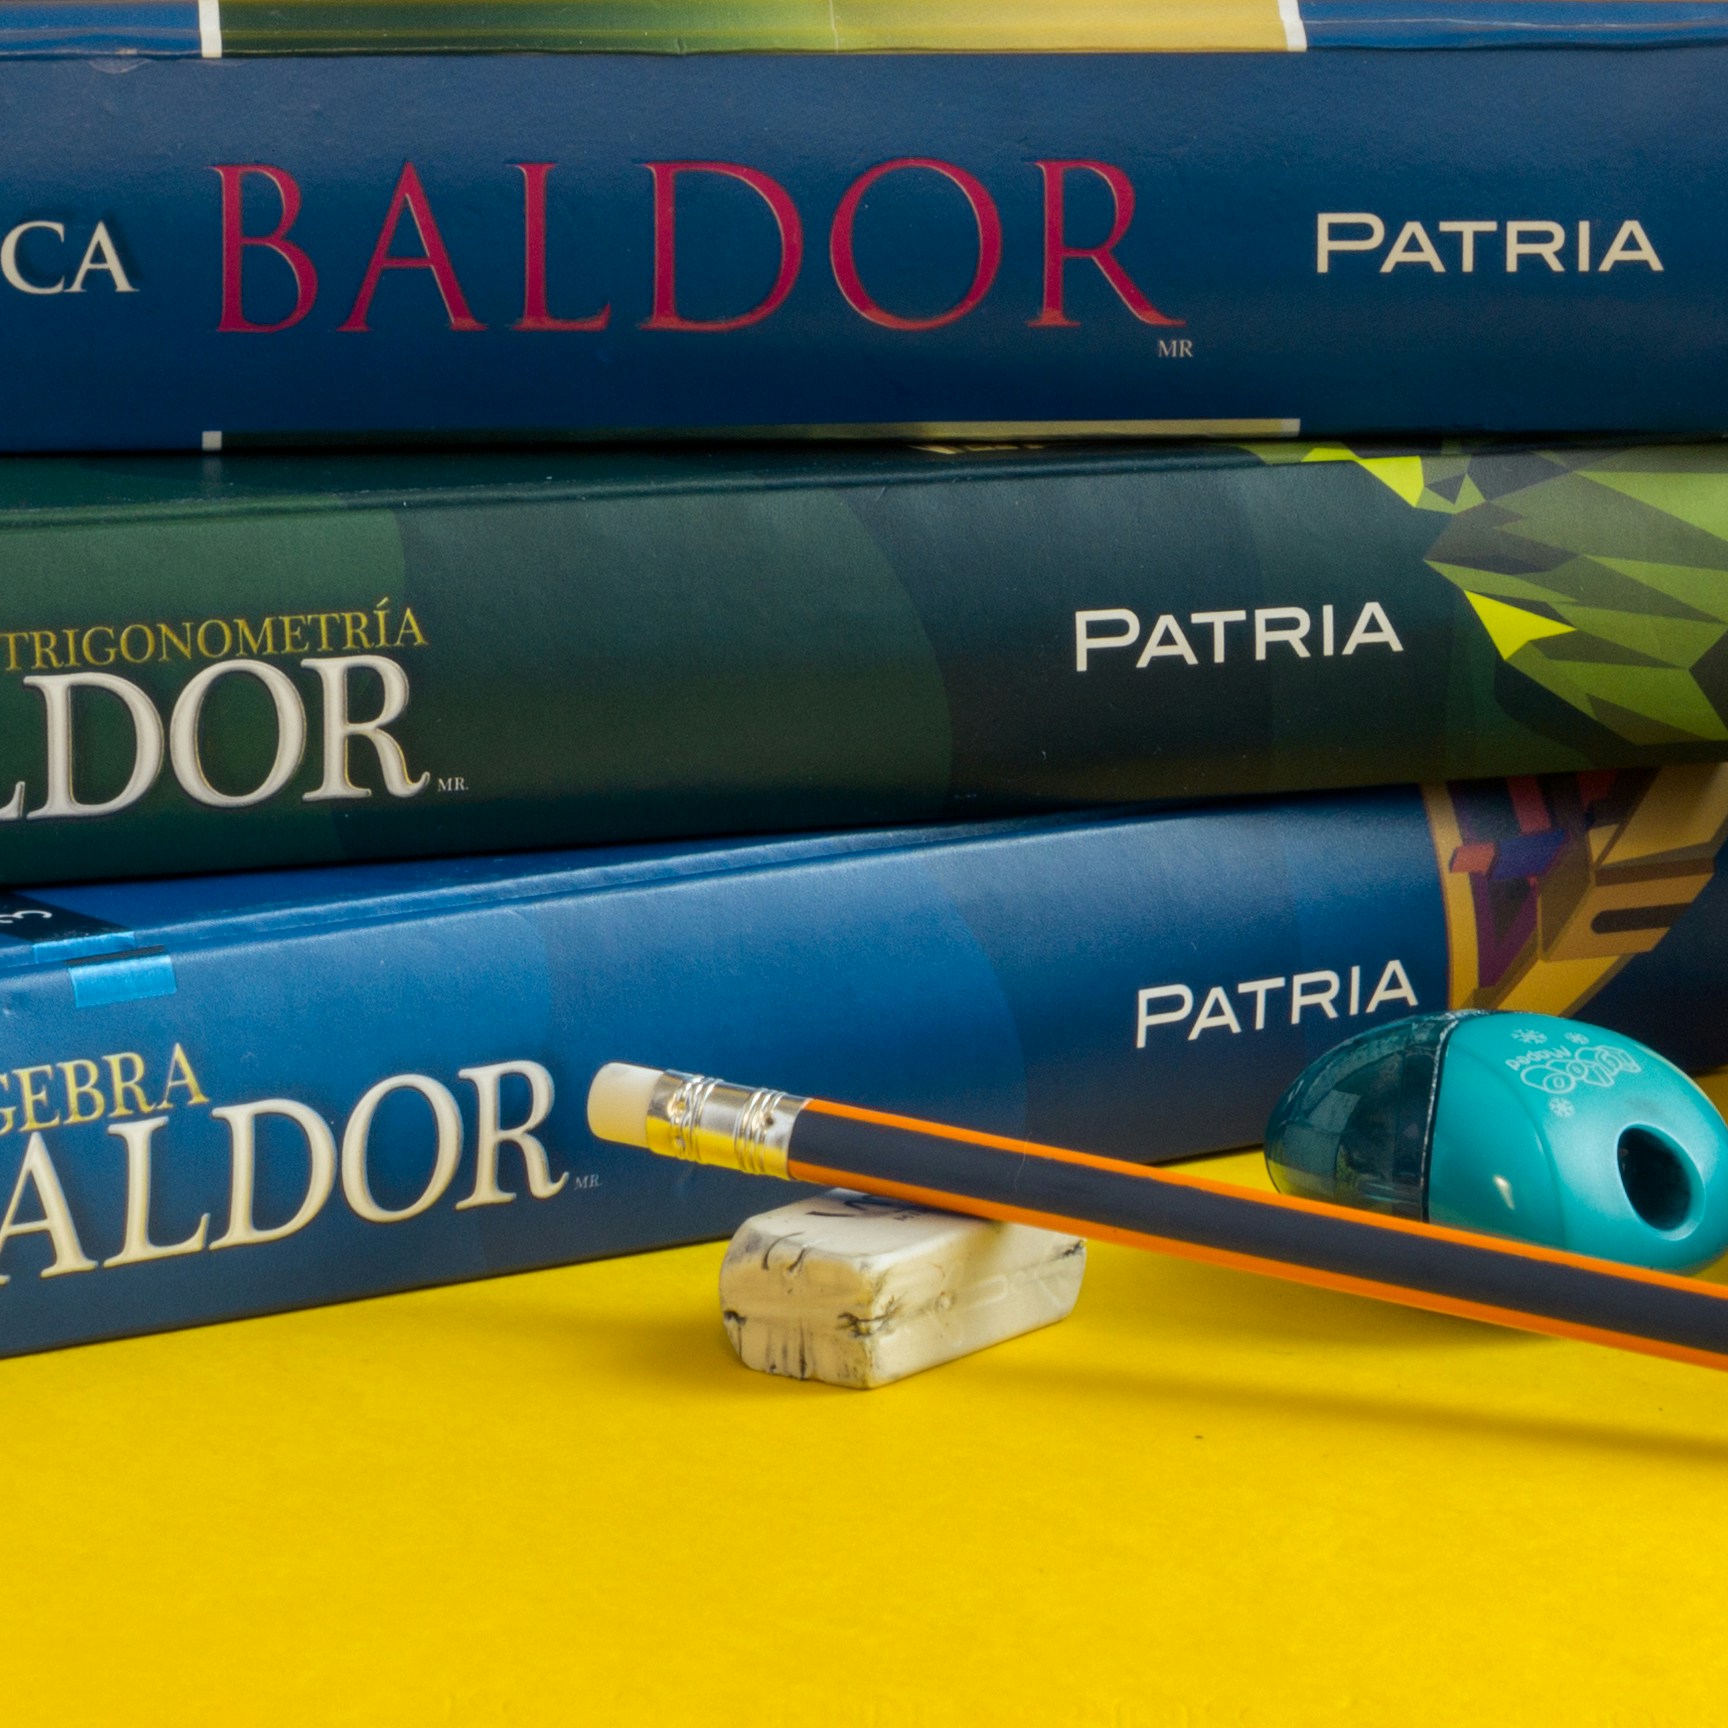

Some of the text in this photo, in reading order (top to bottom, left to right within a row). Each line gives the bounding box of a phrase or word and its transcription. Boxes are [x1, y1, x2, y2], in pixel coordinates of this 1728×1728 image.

[205, 156, 1186, 333] BALDOR
[1315, 212, 1665, 273] PATRIA
[1157, 339, 1194, 358] MR
[1075, 601, 1405, 672] PATRIA
[1136, 959, 1418, 1049] PATRIA
